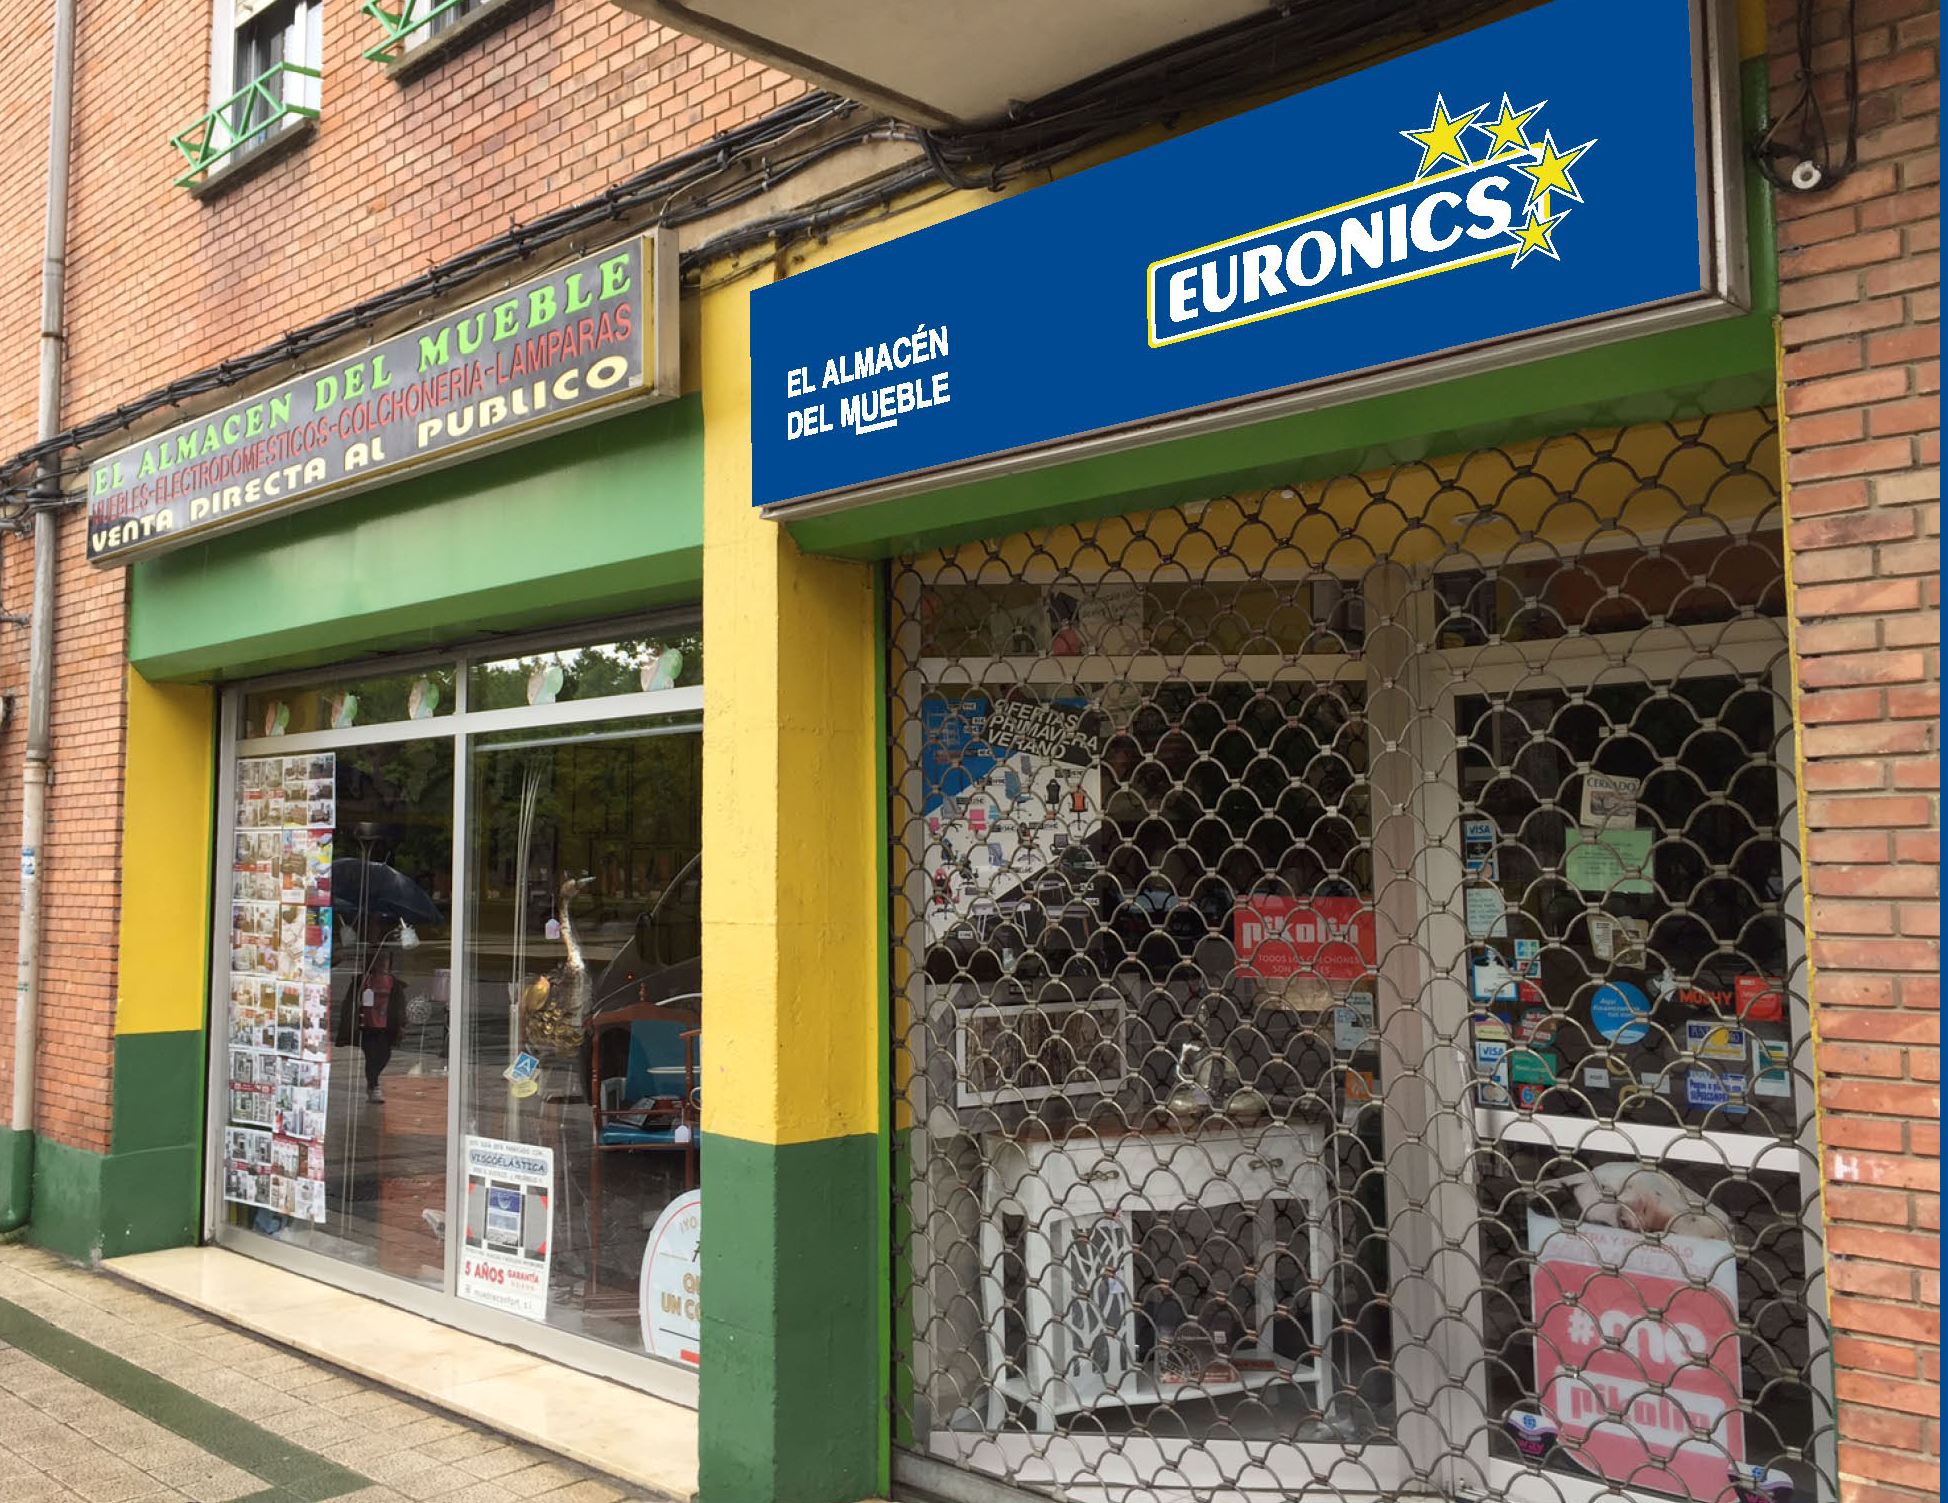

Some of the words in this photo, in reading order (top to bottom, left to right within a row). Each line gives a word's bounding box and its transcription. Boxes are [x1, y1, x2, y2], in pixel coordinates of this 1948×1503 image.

[1169, 176, 1512, 323] EURONICS
[94, 461, 124, 496] EL
[137, 392, 292, 480] ALMACEN
[313, 355, 393, 412] DEL
[418, 253, 632, 373] MUEBLE
[788, 366, 817, 399] EL
[822, 323, 949, 389] ALMACÉN
[788, 404, 834, 440] DEL
[841, 371, 951, 435] MUEBLE
[92, 508, 173, 552] VENTA
[189, 457, 326, 521] DIRECTA
[344, 437, 386, 472] AL
[417, 355, 629, 449] PUBLICO
[1469, 825, 1491, 834] VISA
[474, 1262, 505, 1285] AÑOS
